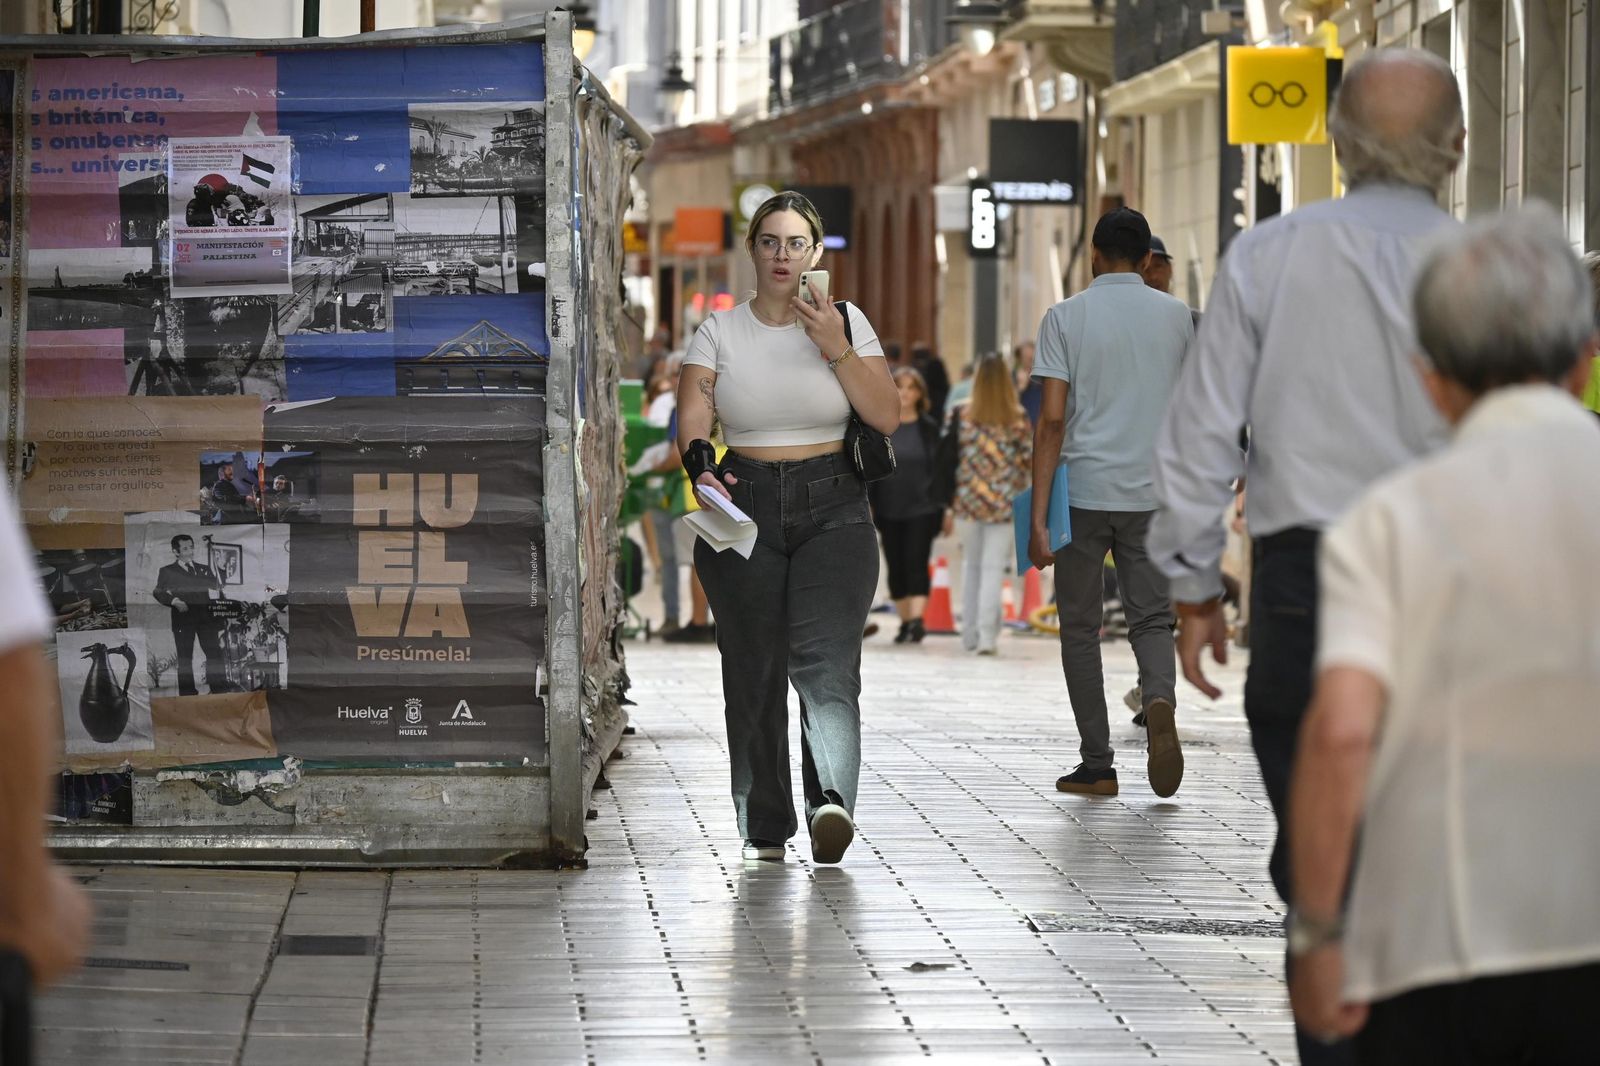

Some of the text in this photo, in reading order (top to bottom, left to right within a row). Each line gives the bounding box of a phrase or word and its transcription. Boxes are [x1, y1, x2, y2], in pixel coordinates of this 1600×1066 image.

[48, 82, 184, 102] americana,
[196, 240, 264, 249] MANIFESTACIÓN
[47, 428, 161, 441] Con lo que conoces
[55, 441, 155, 453] y lo que te queda
[49, 456, 68, 466] por
[125, 454, 161, 463] tienes
[49, 466, 163, 478] motivos suficientes
[48, 480, 164, 494] para estar orgulloso
[353, 473, 479, 528] HU
[358, 531, 468, 584] EL
[345, 586, 471, 638] VA
[357, 645, 471, 662] Presúmela!
[338, 706, 389, 719] Huelva
